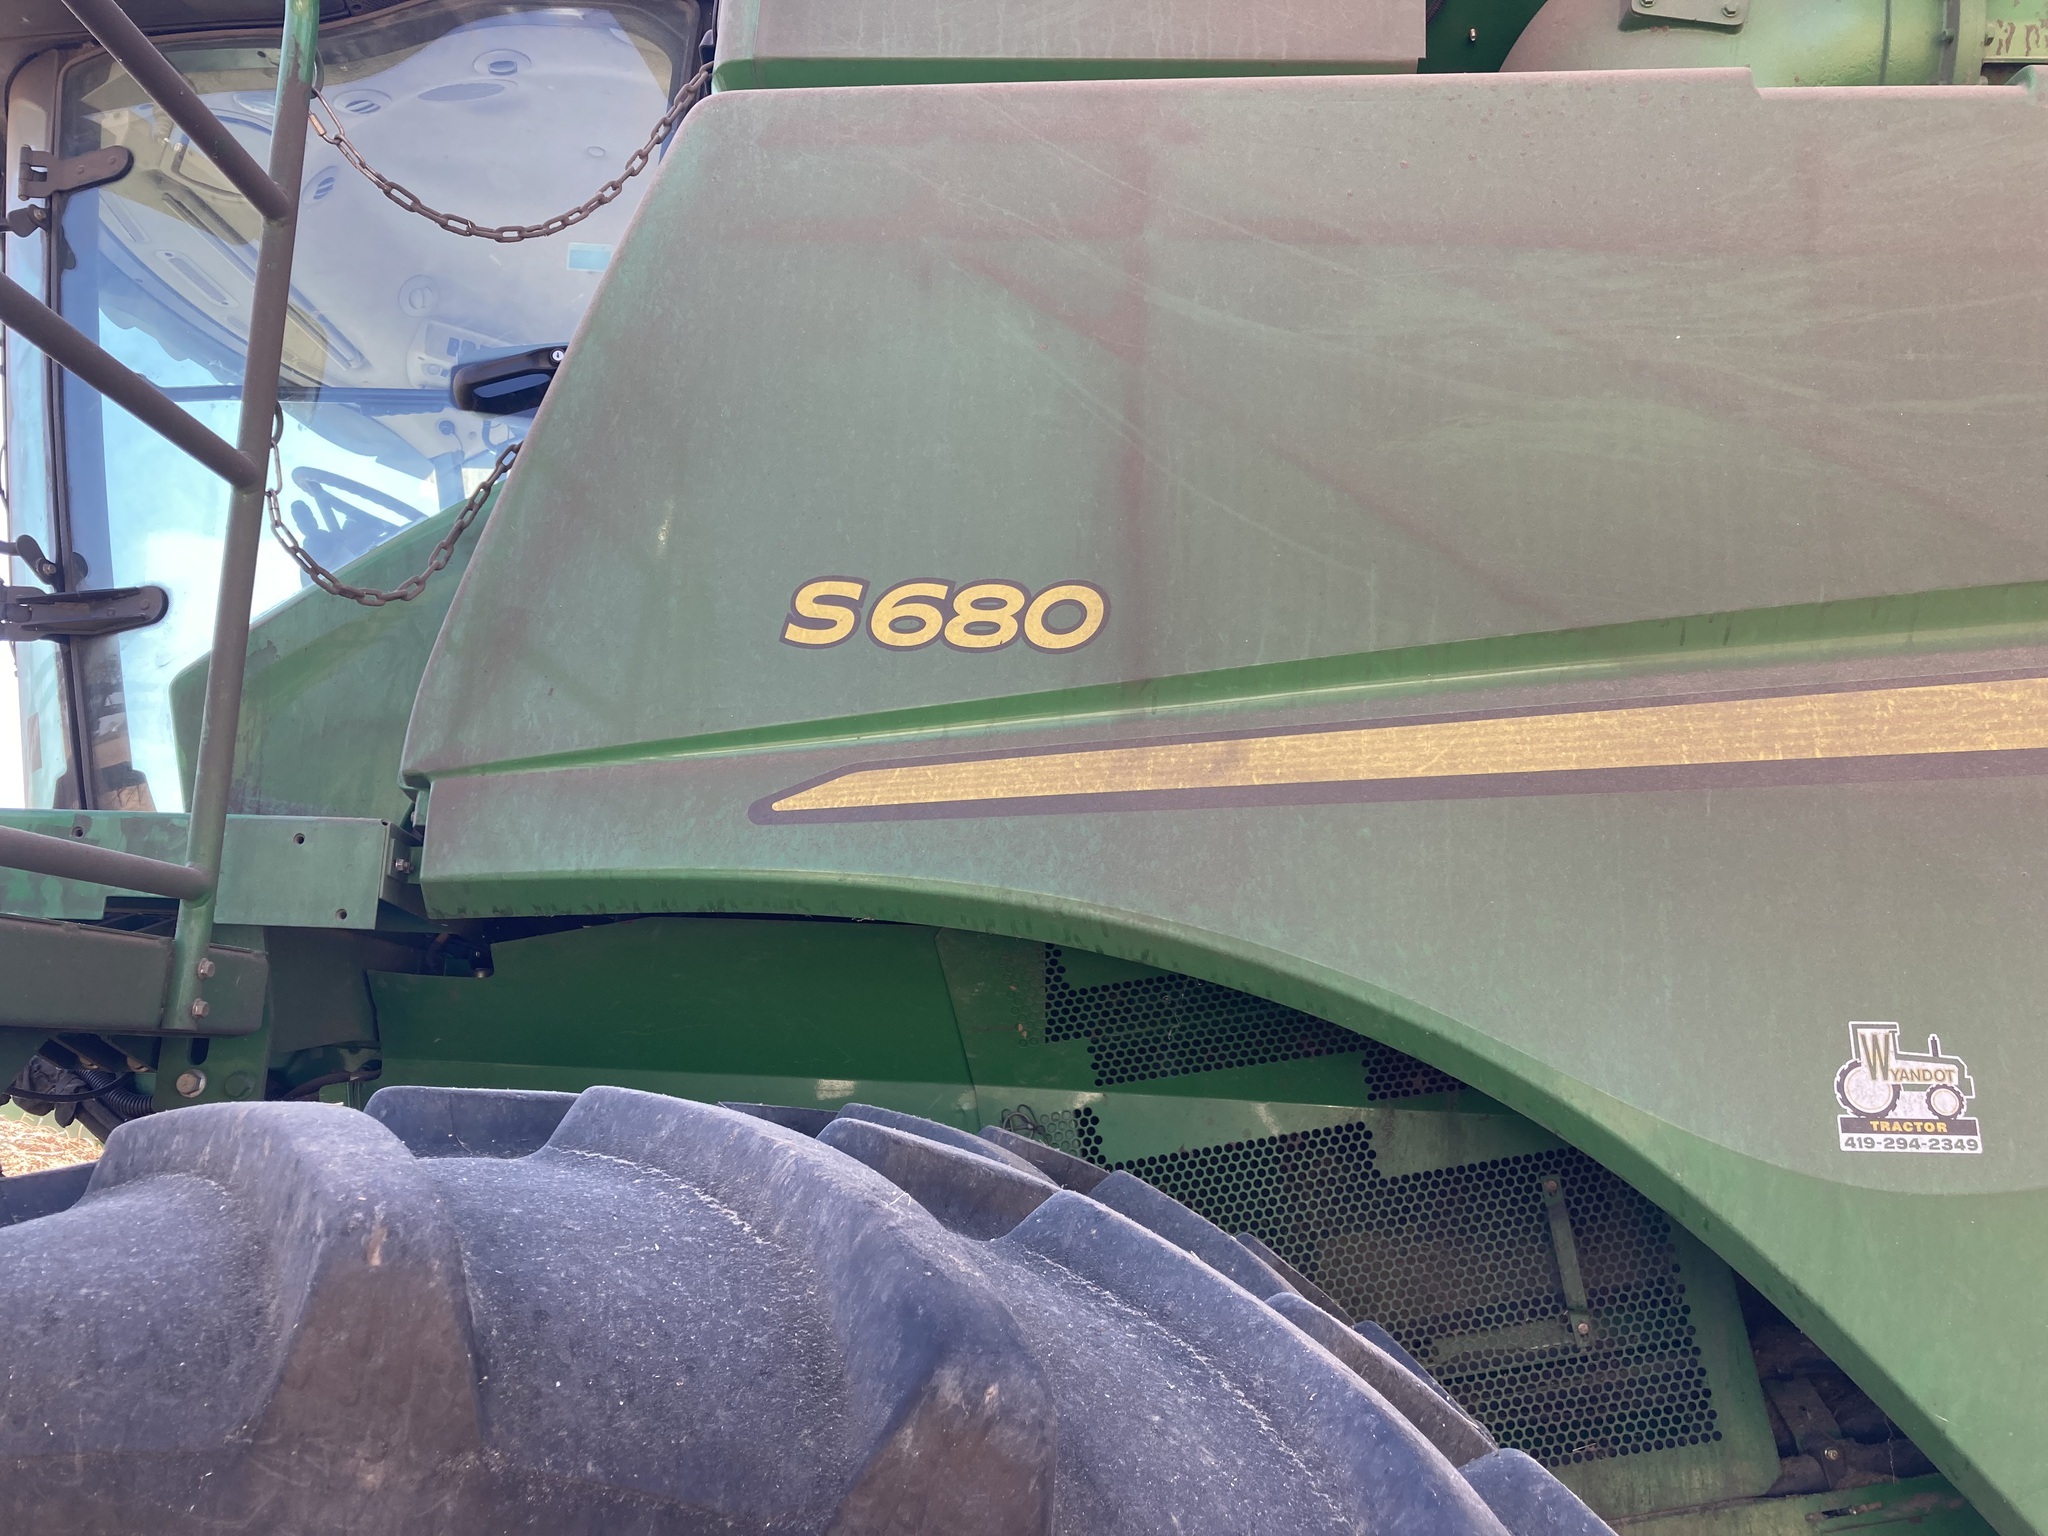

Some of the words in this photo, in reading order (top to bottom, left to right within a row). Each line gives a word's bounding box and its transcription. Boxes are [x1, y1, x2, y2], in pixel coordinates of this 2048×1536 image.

[781, 577, 1108, 652] S680
[1870, 1120, 1949, 1133] TRACTOR
[1844, 1136, 1979, 1151] 419-294-2349
